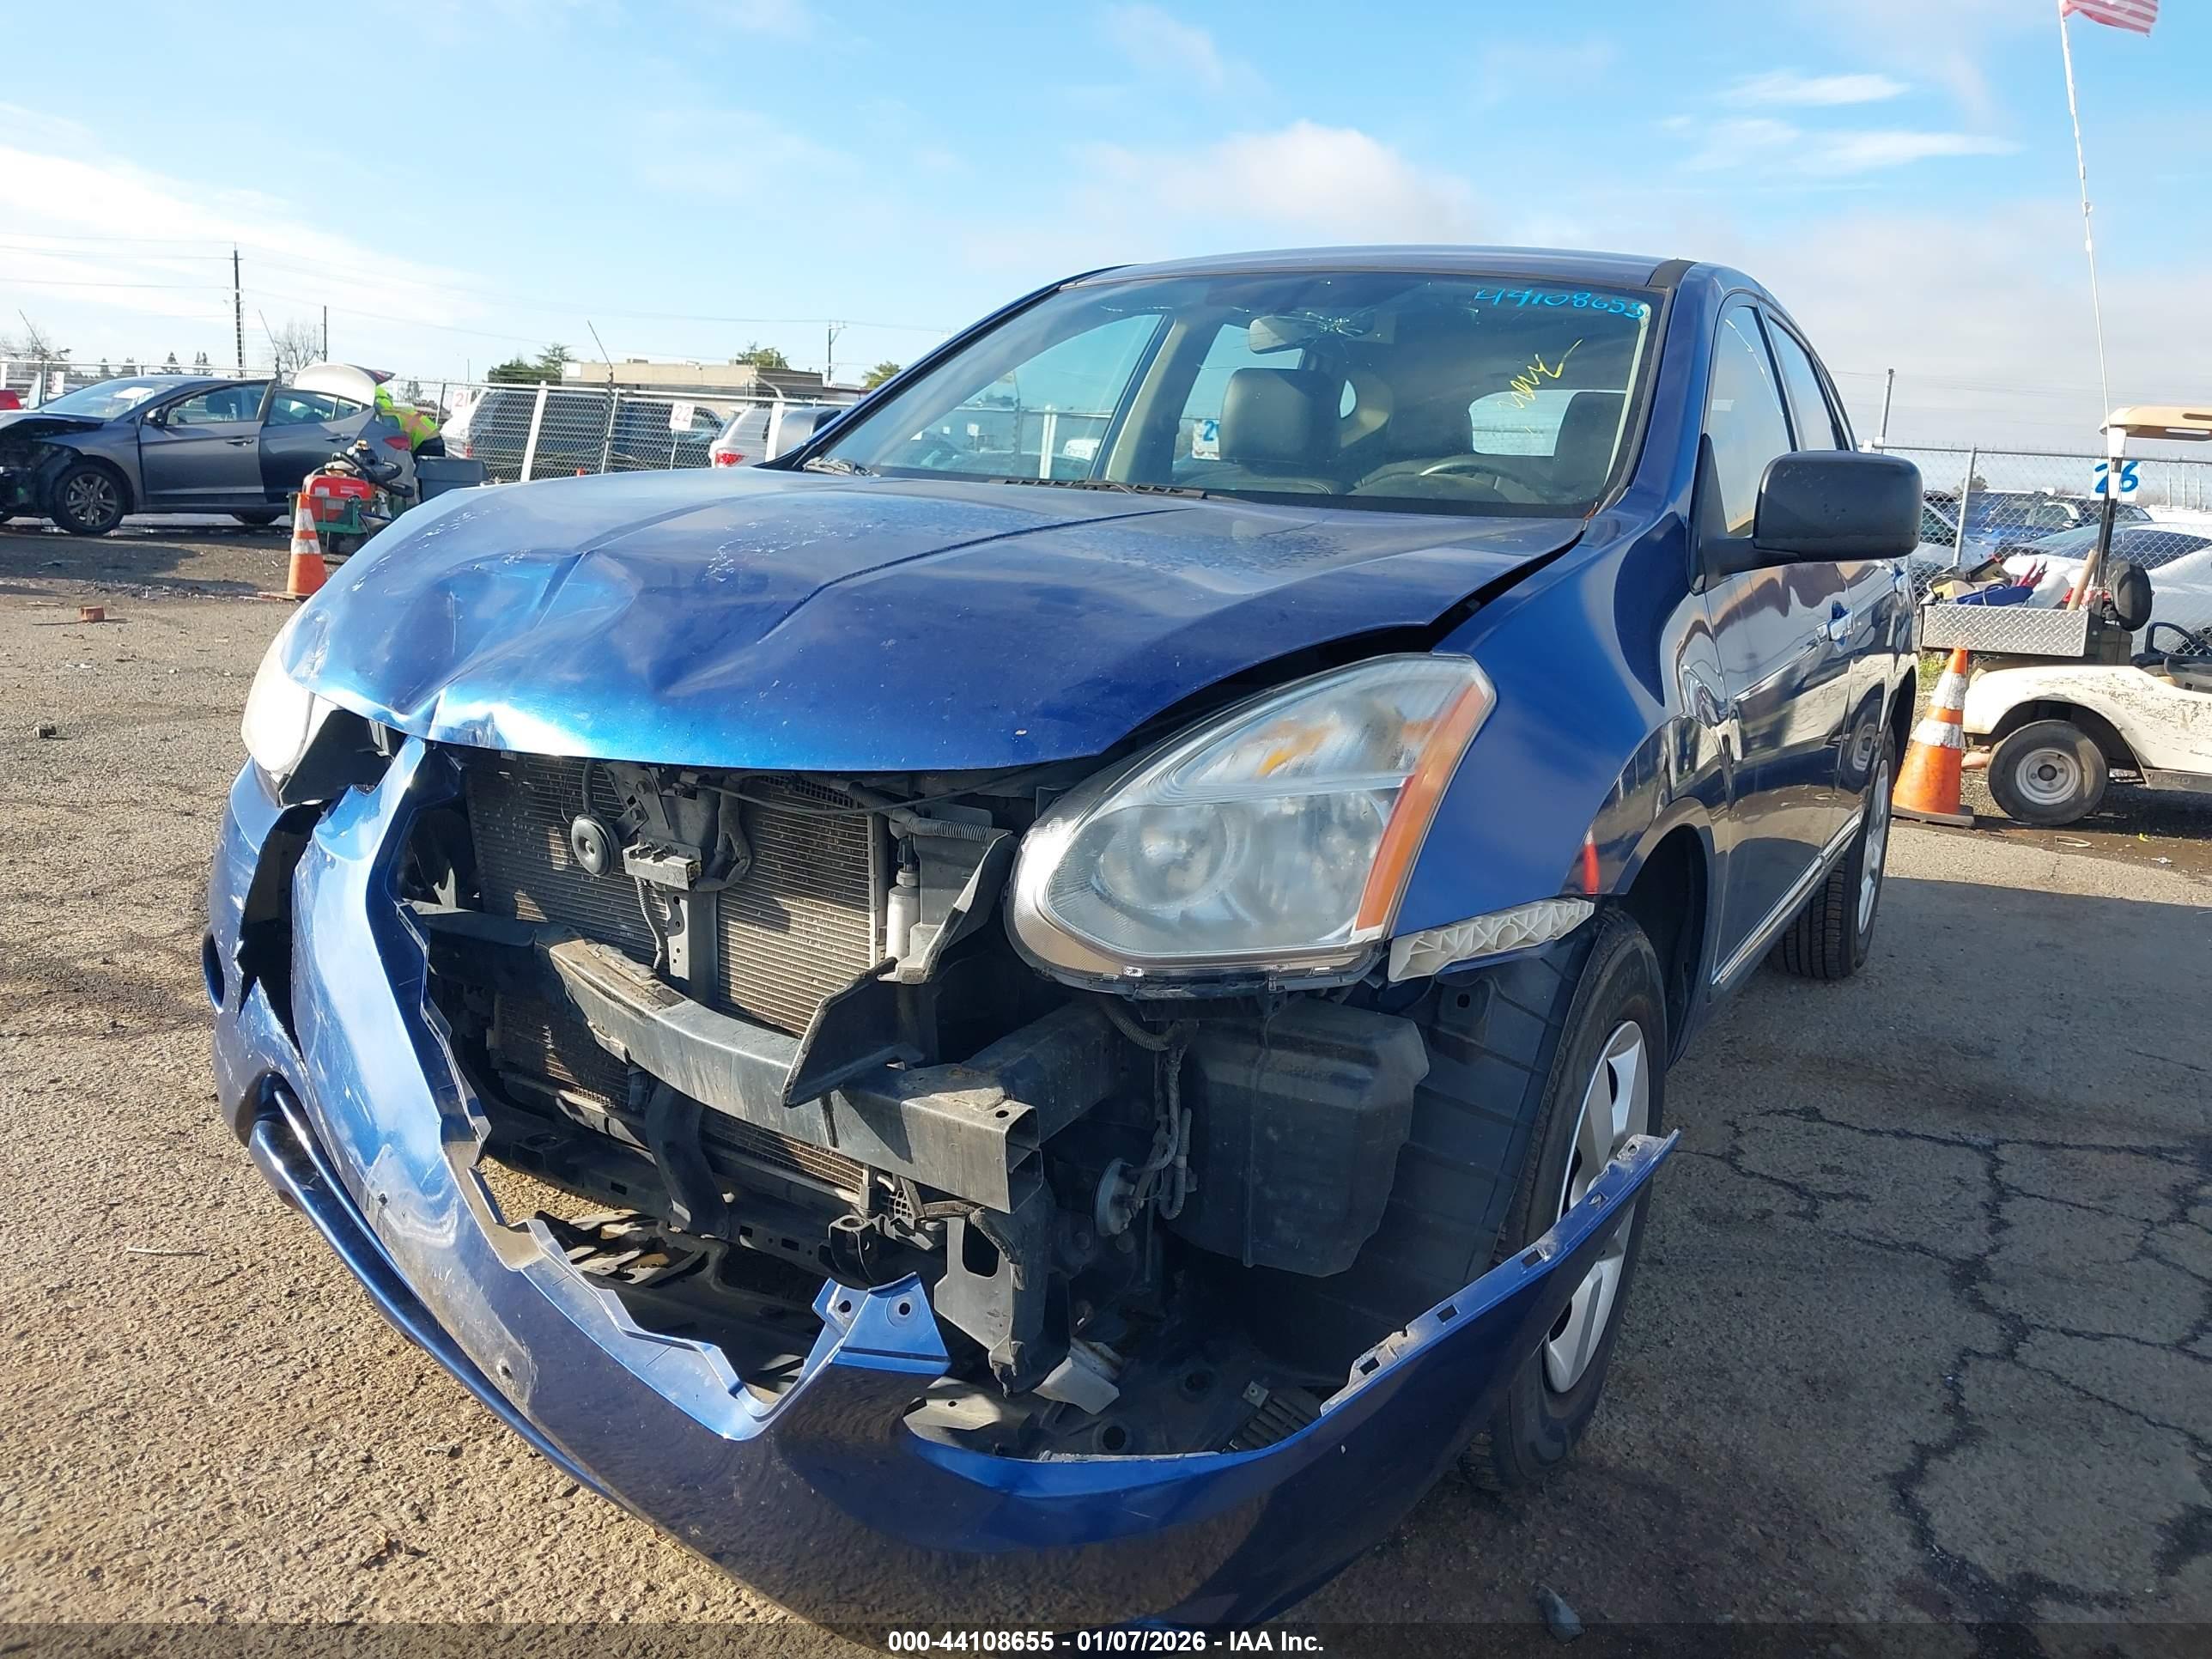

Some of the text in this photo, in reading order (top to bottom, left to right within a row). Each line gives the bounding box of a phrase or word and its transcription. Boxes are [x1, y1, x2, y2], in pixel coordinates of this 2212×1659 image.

[1474, 288, 1644, 319] 44108655
[673, 404, 691, 422] 22
[2094, 460, 2139, 494] 26
